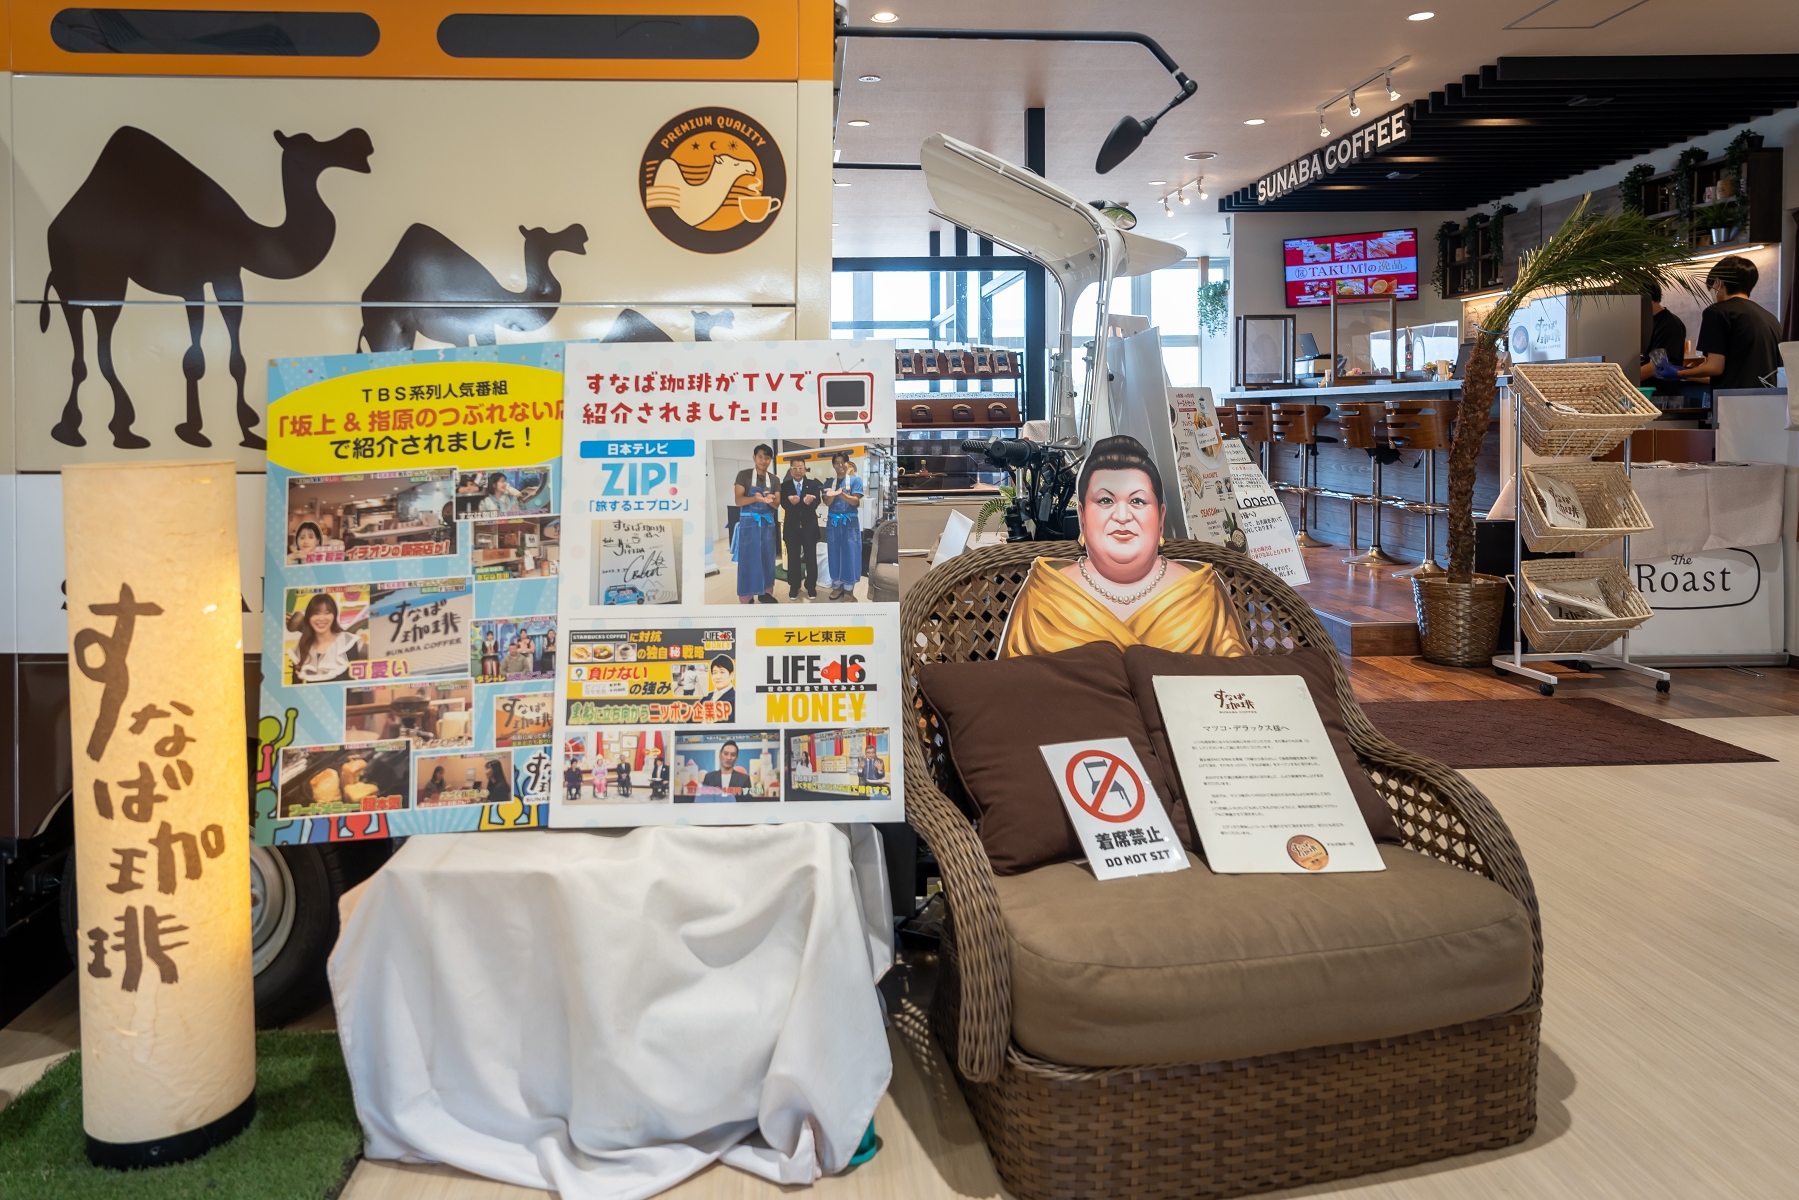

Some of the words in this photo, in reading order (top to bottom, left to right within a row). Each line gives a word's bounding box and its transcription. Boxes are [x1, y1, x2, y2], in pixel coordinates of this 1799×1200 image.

[660, 115, 712, 149] PREMIUM
[717, 115, 767, 147] QUALITY
[1258, 153, 1322, 202] SUNABA
[1325, 109, 1406, 170] COFFEE
[362, 380, 508, 402] TBS系列人気番組
[586, 370, 812, 394] すなば珈琲がTVで
[582, 401, 778, 425] 紹介されました!!
[330, 427, 531, 460] で紹介されました!
[607, 442, 669, 456] 日本テレビ
[601, 462, 678, 497] ZIP!
[588, 498, 689, 513] 「旅するエプロン」
[1243, 495, 1276, 508] open
[1671, 554, 1693, 566] The
[1634, 563, 1732, 593] Roast
[423, 638, 462, 650] COFFEE
[784, 631, 847, 644] テレビ東京
[350, 659, 410, 680] 可愛い
[766, 655, 821, 684] LIFE
[840, 654, 866, 683] IS
[629, 682, 672, 695] の強み
[766, 692, 867, 723] MONEY
[1095, 825, 1165, 851] 着席禁止
[1105, 856, 1123, 868] DO
[1125, 852, 1148, 865] NOT
[1150, 848, 1171, 861] SIT
